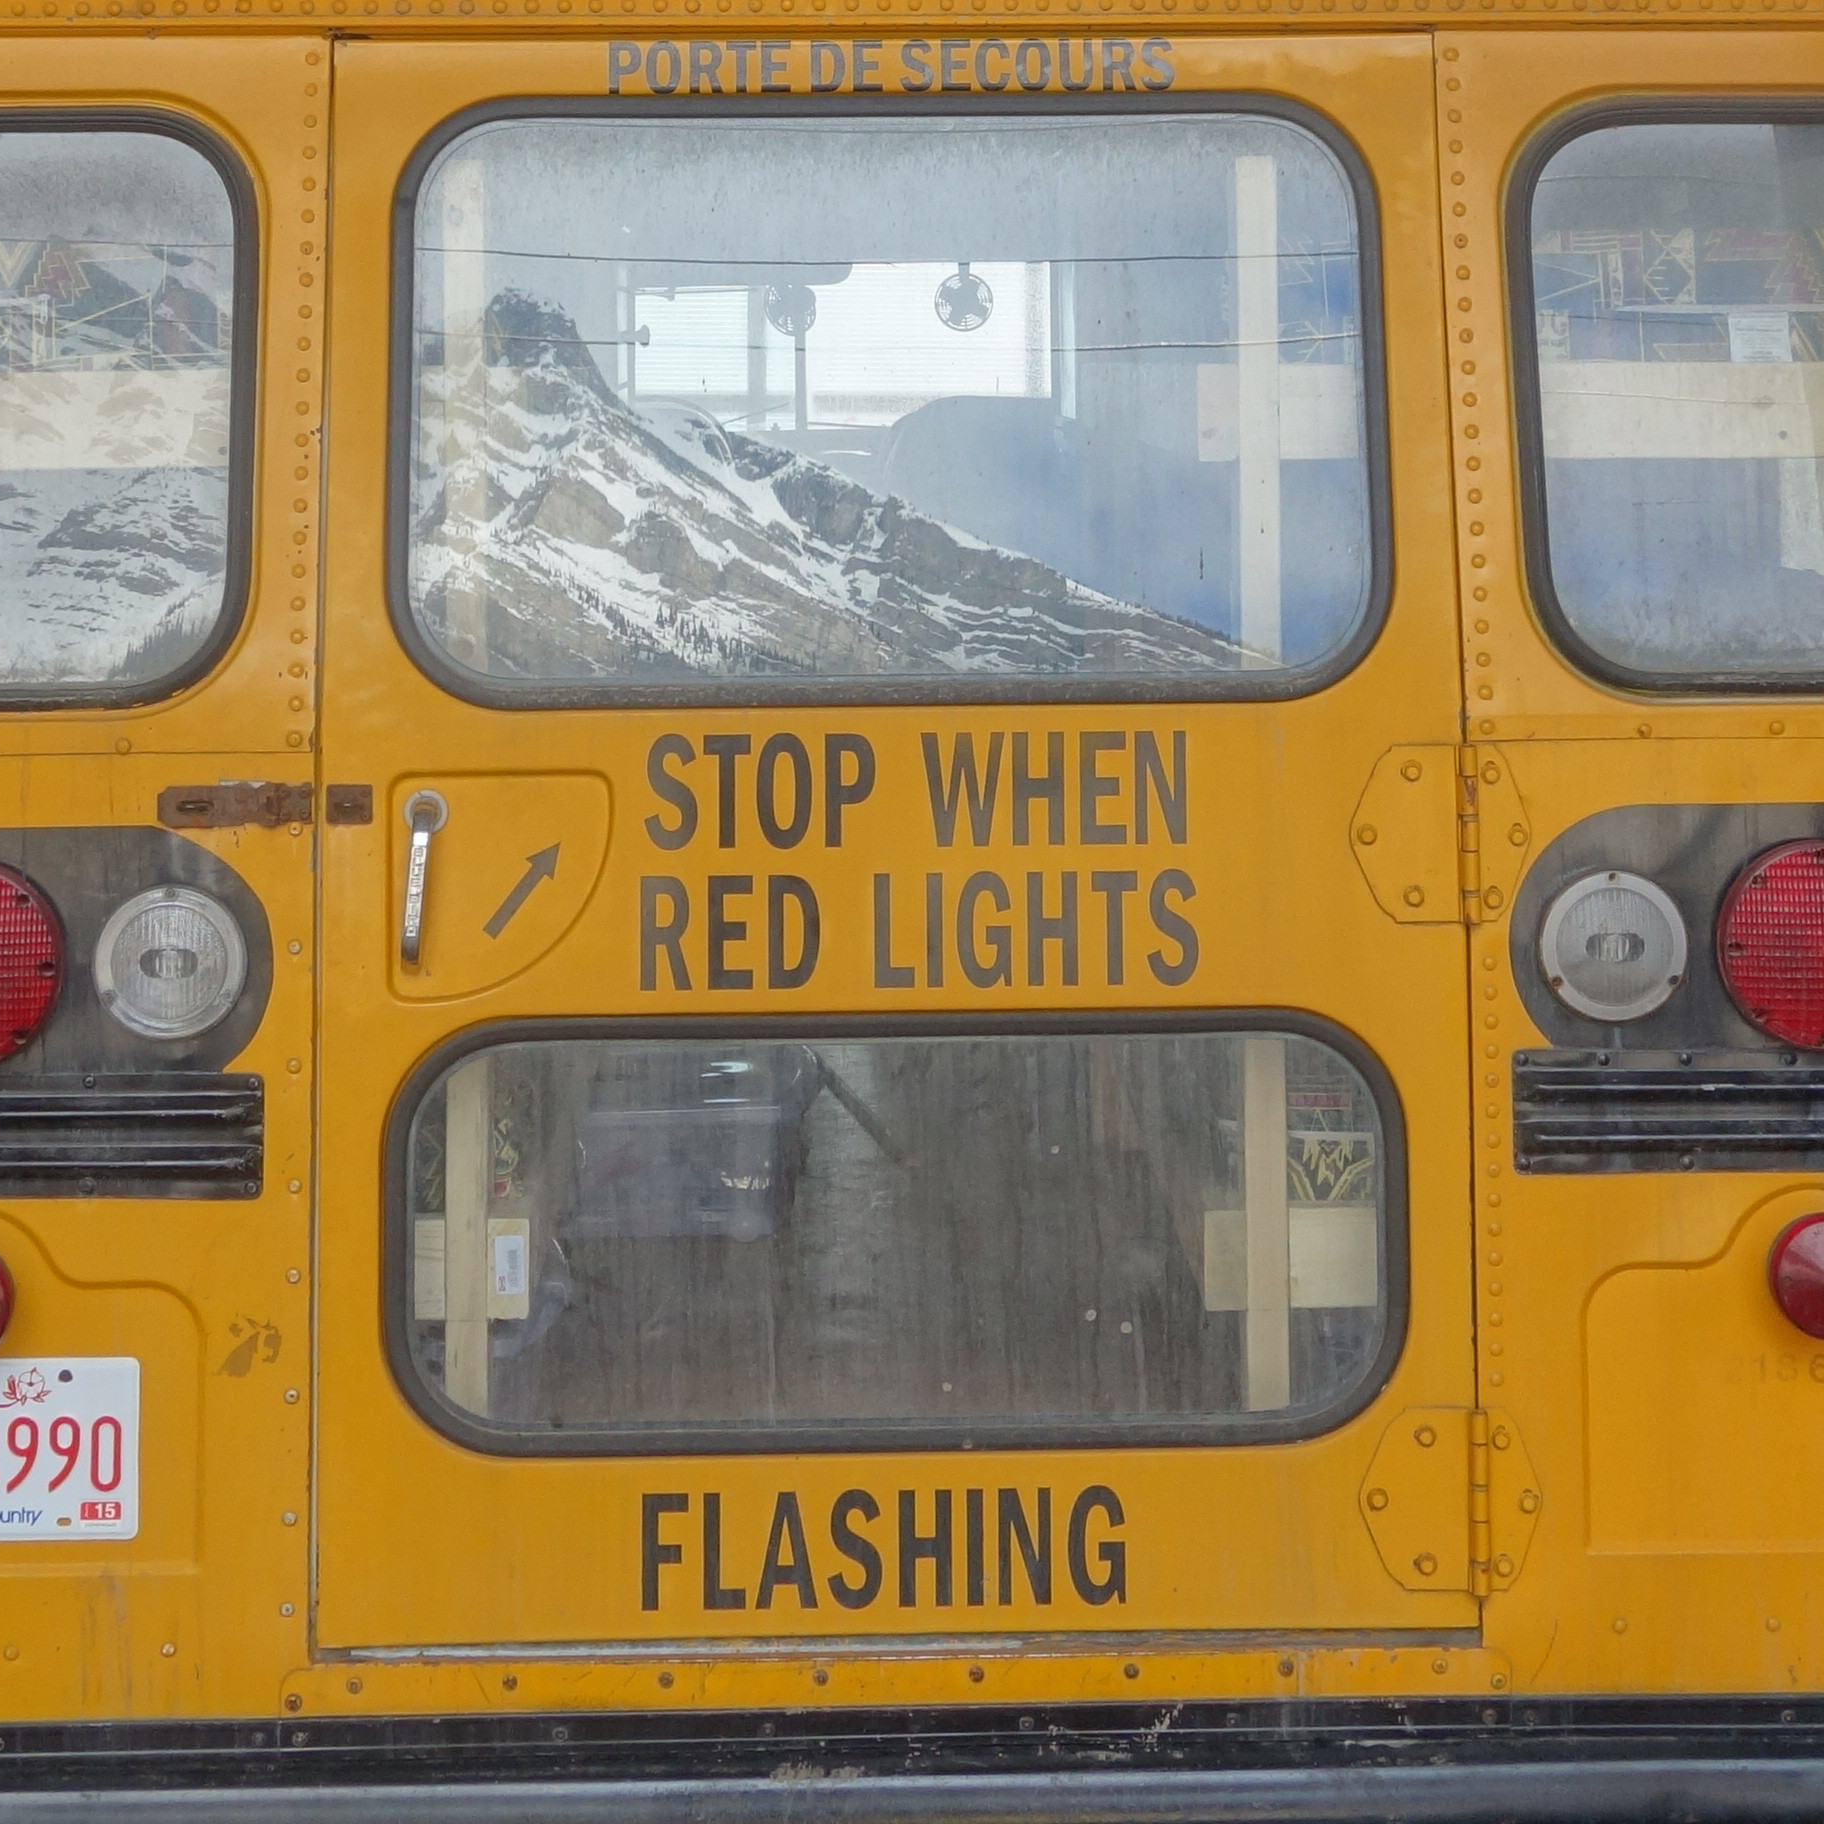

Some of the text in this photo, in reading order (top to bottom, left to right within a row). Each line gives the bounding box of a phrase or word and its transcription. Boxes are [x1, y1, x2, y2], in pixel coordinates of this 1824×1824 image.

[608, 36, 1176, 94] PORTE DE SECOURS
[644, 730, 1188, 850] STOP WHEN
[639, 869, 1201, 992] RED LIGHTS
[94, 1503, 116, 1519] 15
[640, 1485, 1128, 1612] FLASHING
